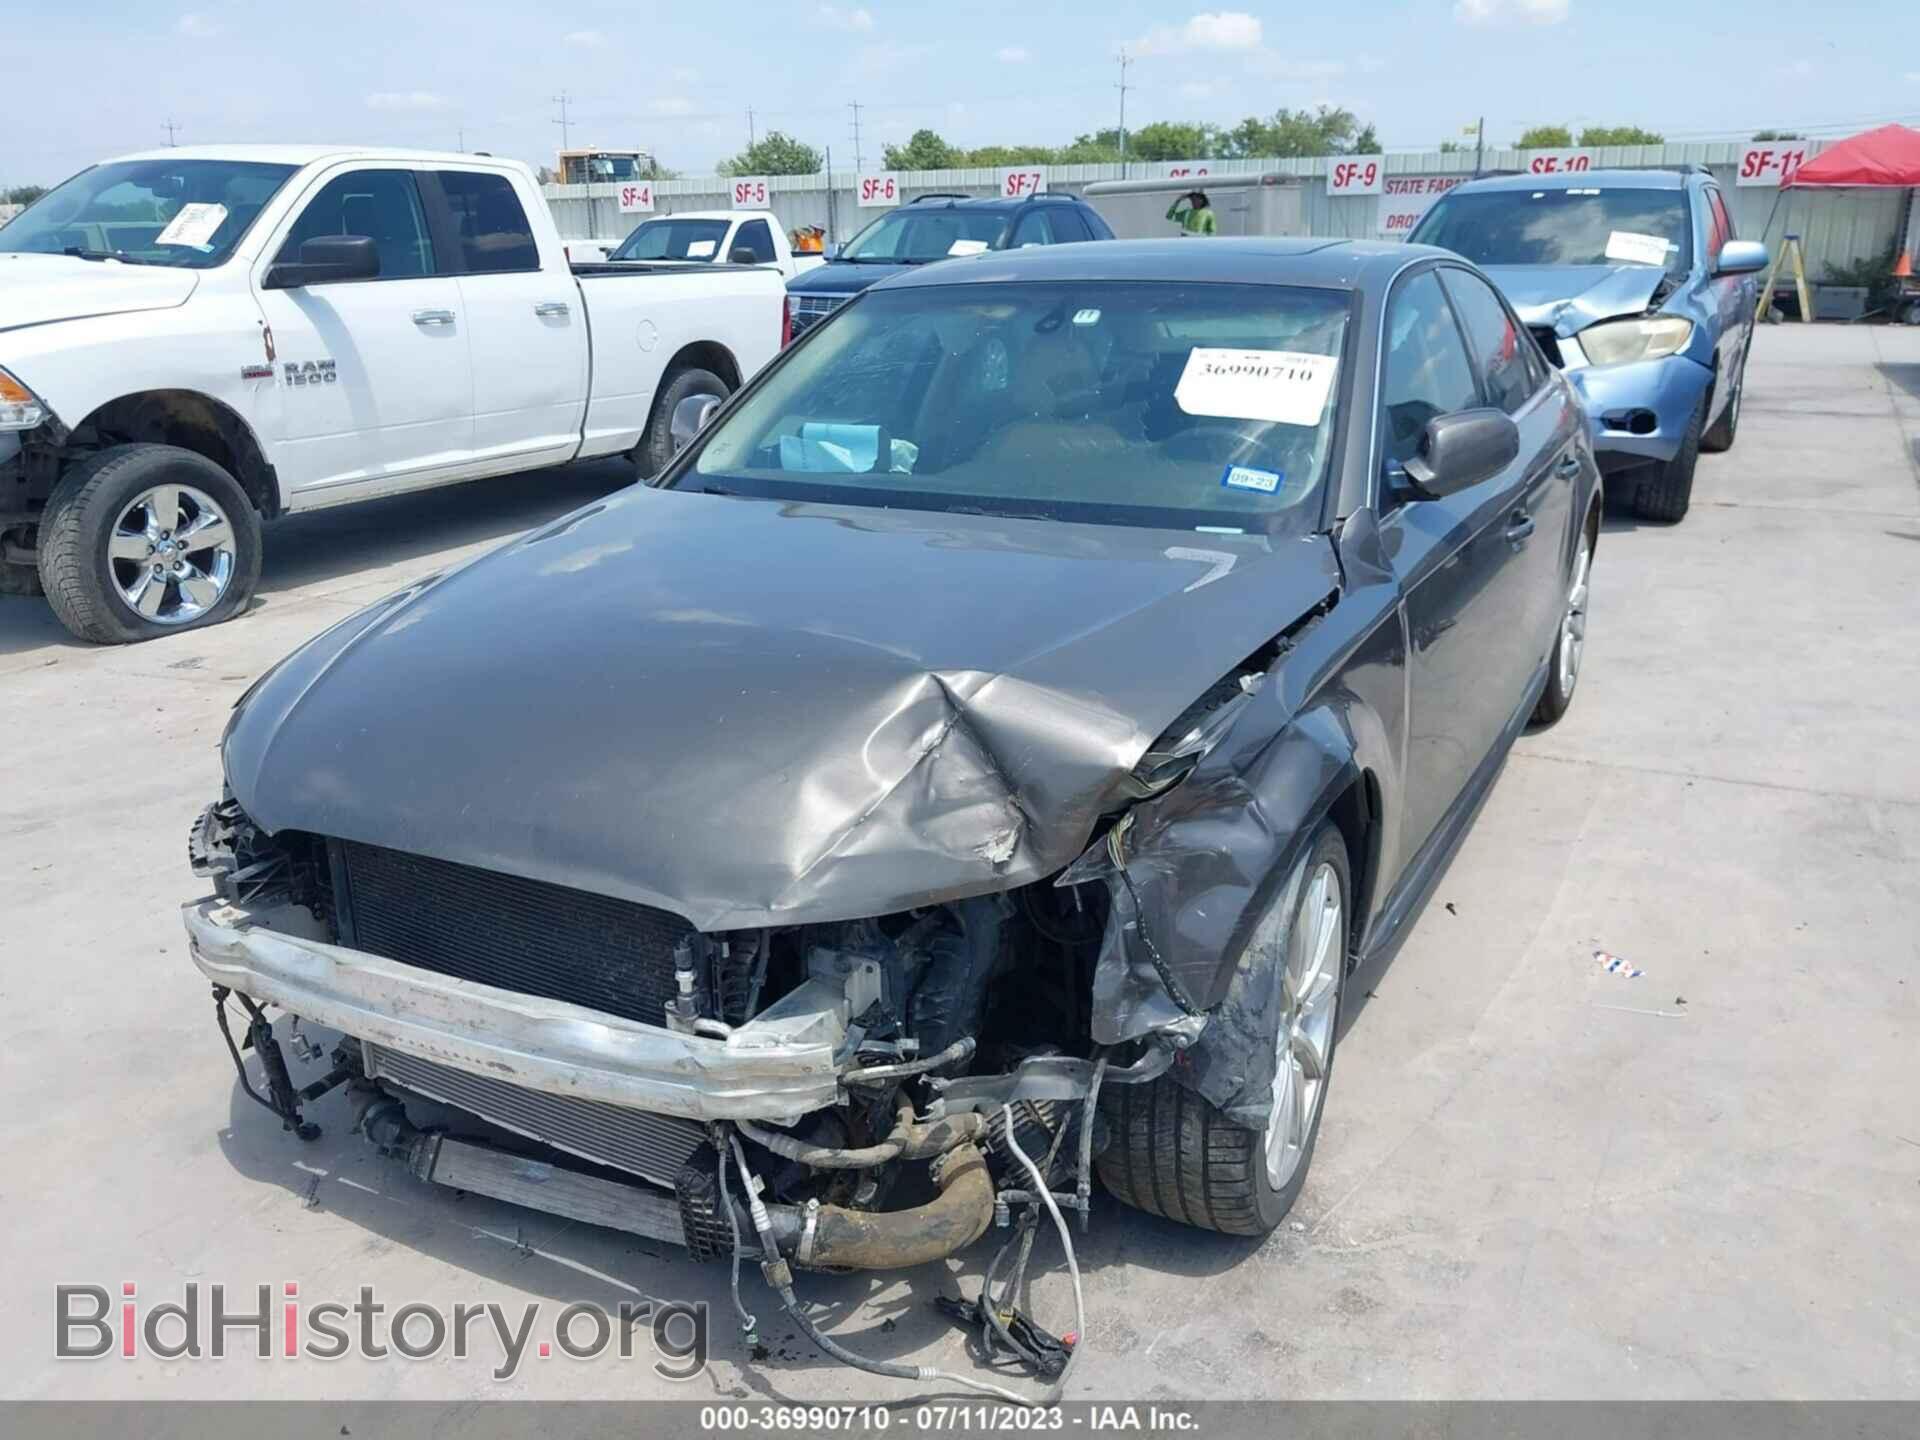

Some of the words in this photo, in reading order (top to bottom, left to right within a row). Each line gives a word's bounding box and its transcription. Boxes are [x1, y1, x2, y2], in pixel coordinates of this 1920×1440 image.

[1741, 150, 1803, 177] SF-11
[1006, 174, 1041, 196] SF-7
[1333, 163, 1377, 188] SF-9
[735, 183, 765, 203] SF-5
[862, 178, 894, 200] SF-6
[1386, 179, 1424, 194] STATE
[1427, 178, 1468, 193] FAR
[622, 187, 649, 206] SF-4
[284, 360, 336, 374] RAM
[1204, 363, 1313, 382] 36990710
[286, 372, 337, 386] 1500
